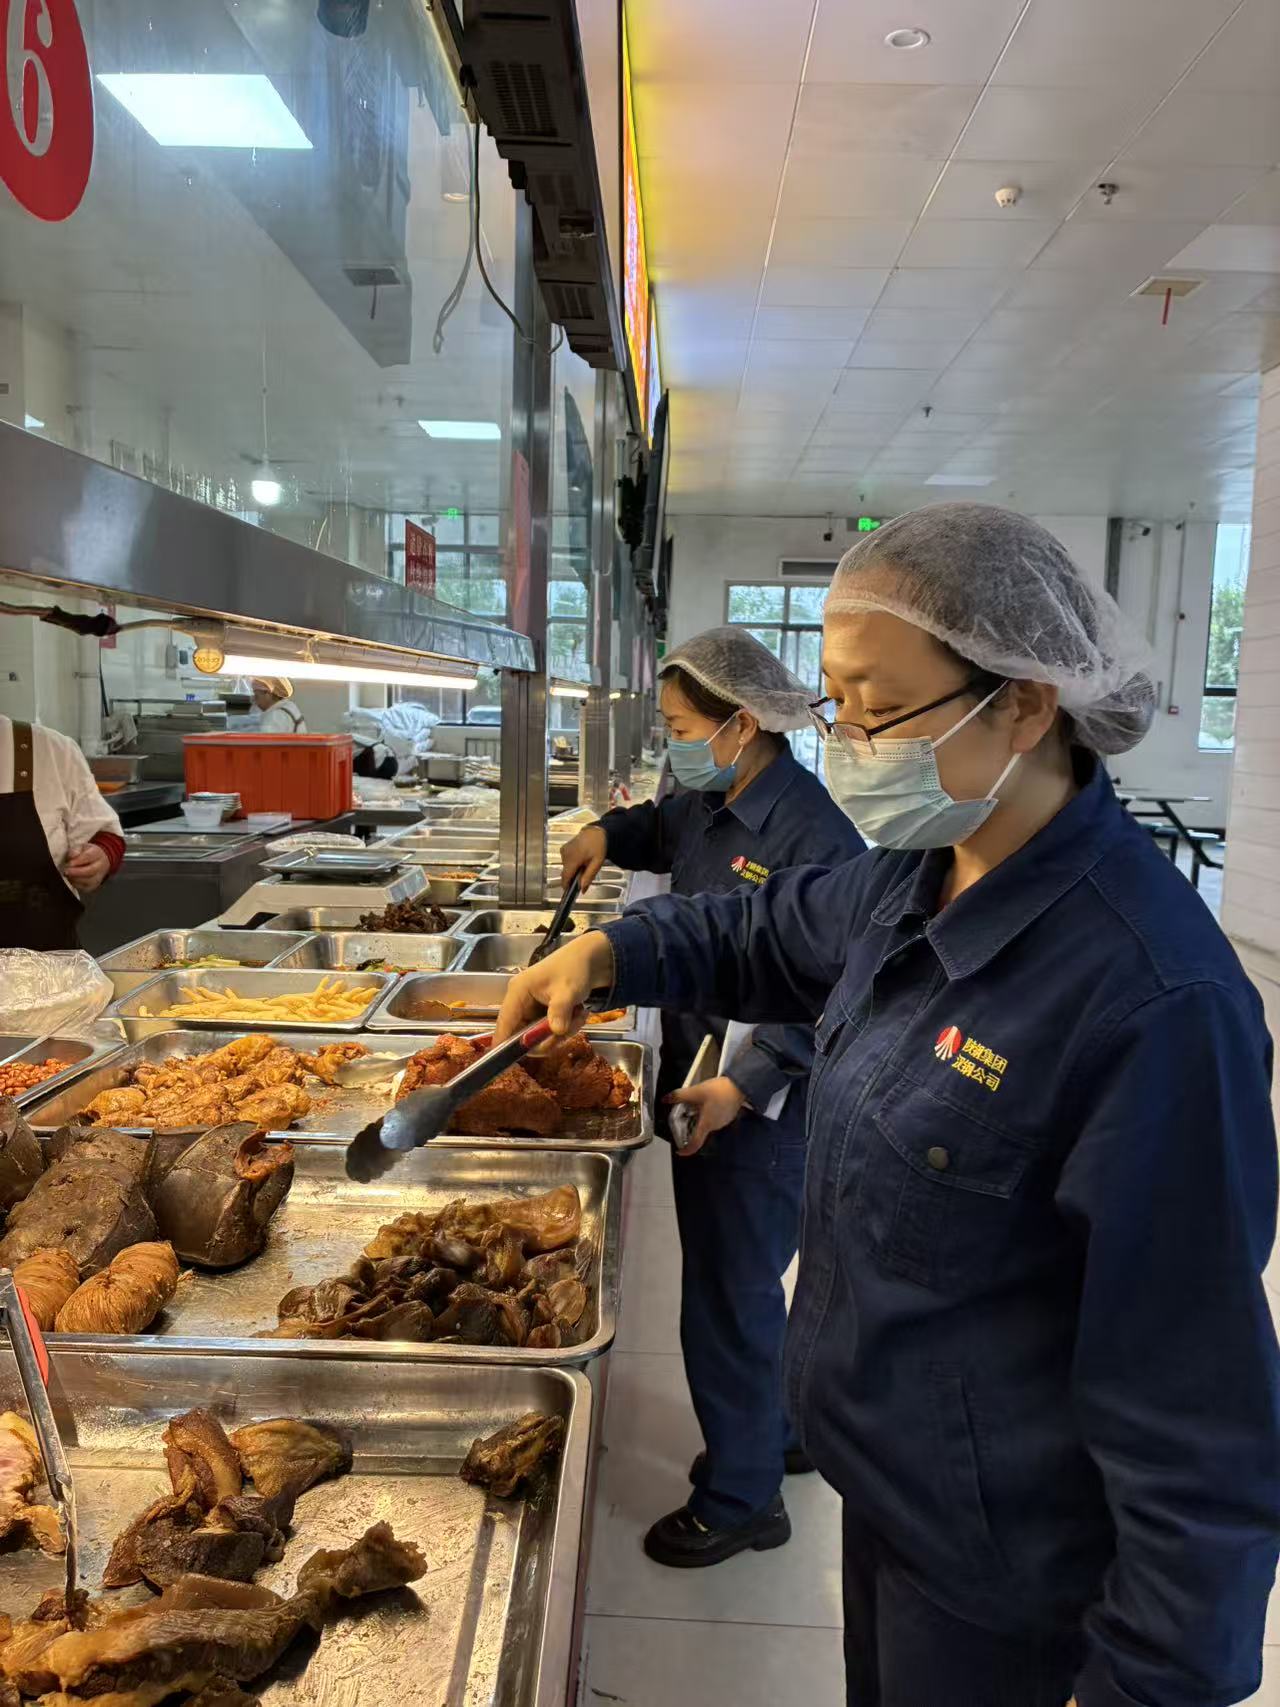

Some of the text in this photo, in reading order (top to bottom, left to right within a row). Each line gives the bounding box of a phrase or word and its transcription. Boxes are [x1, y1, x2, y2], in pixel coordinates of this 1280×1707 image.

[7, 0, 54, 157] 6
[951, 1053, 1001, 1092] 汉钢公司
